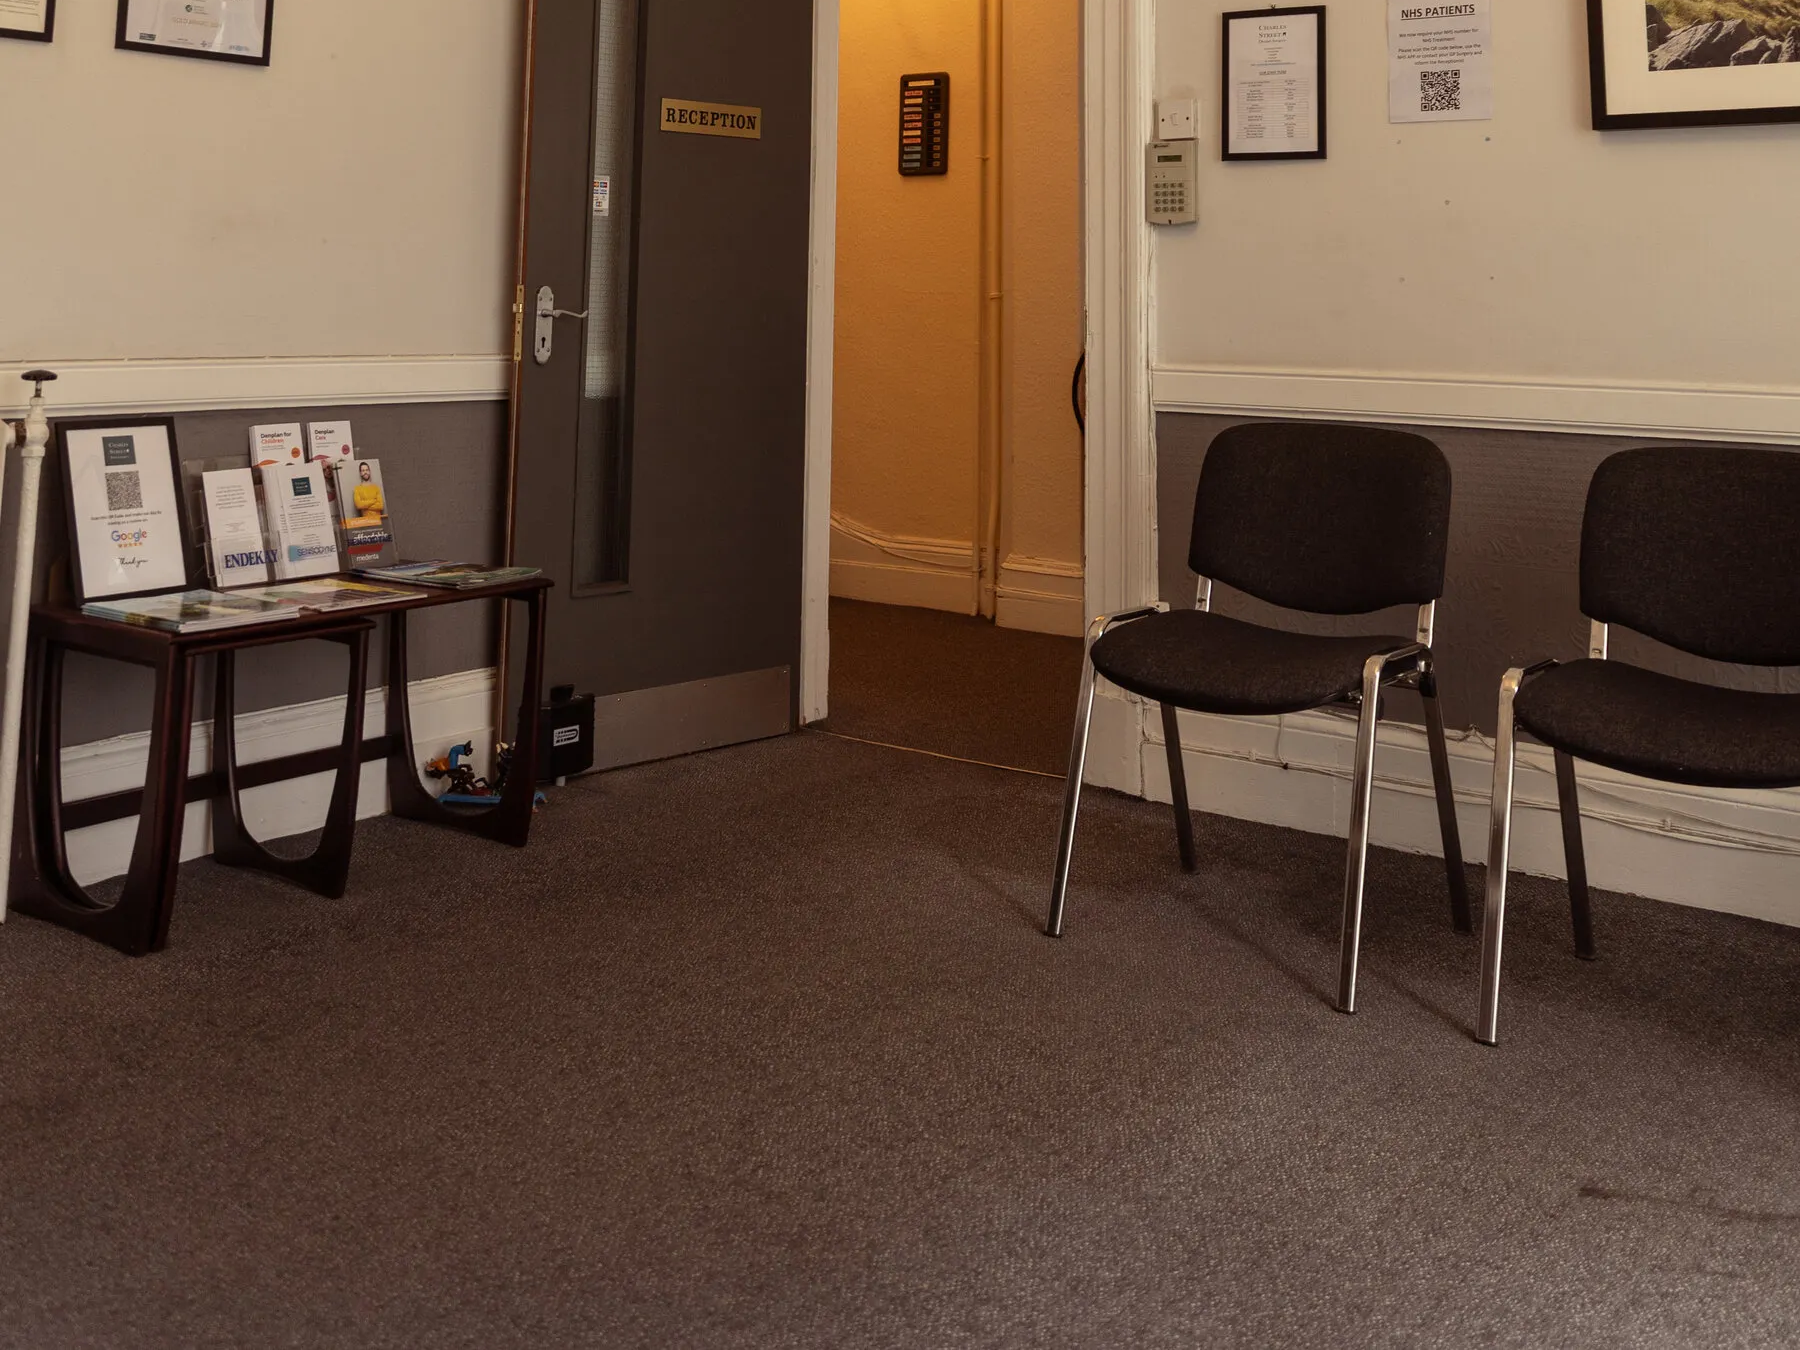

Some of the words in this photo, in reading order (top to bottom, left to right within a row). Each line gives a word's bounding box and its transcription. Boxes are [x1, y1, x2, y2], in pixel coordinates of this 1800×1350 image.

[1401, 8, 1422, 18] NHS
[1426, 4, 1475, 16] PATIENTS
[666, 108, 757, 130] RECEPTION
[111, 528, 147, 541] Google
[224, 549, 278, 569] ENDEKAY
